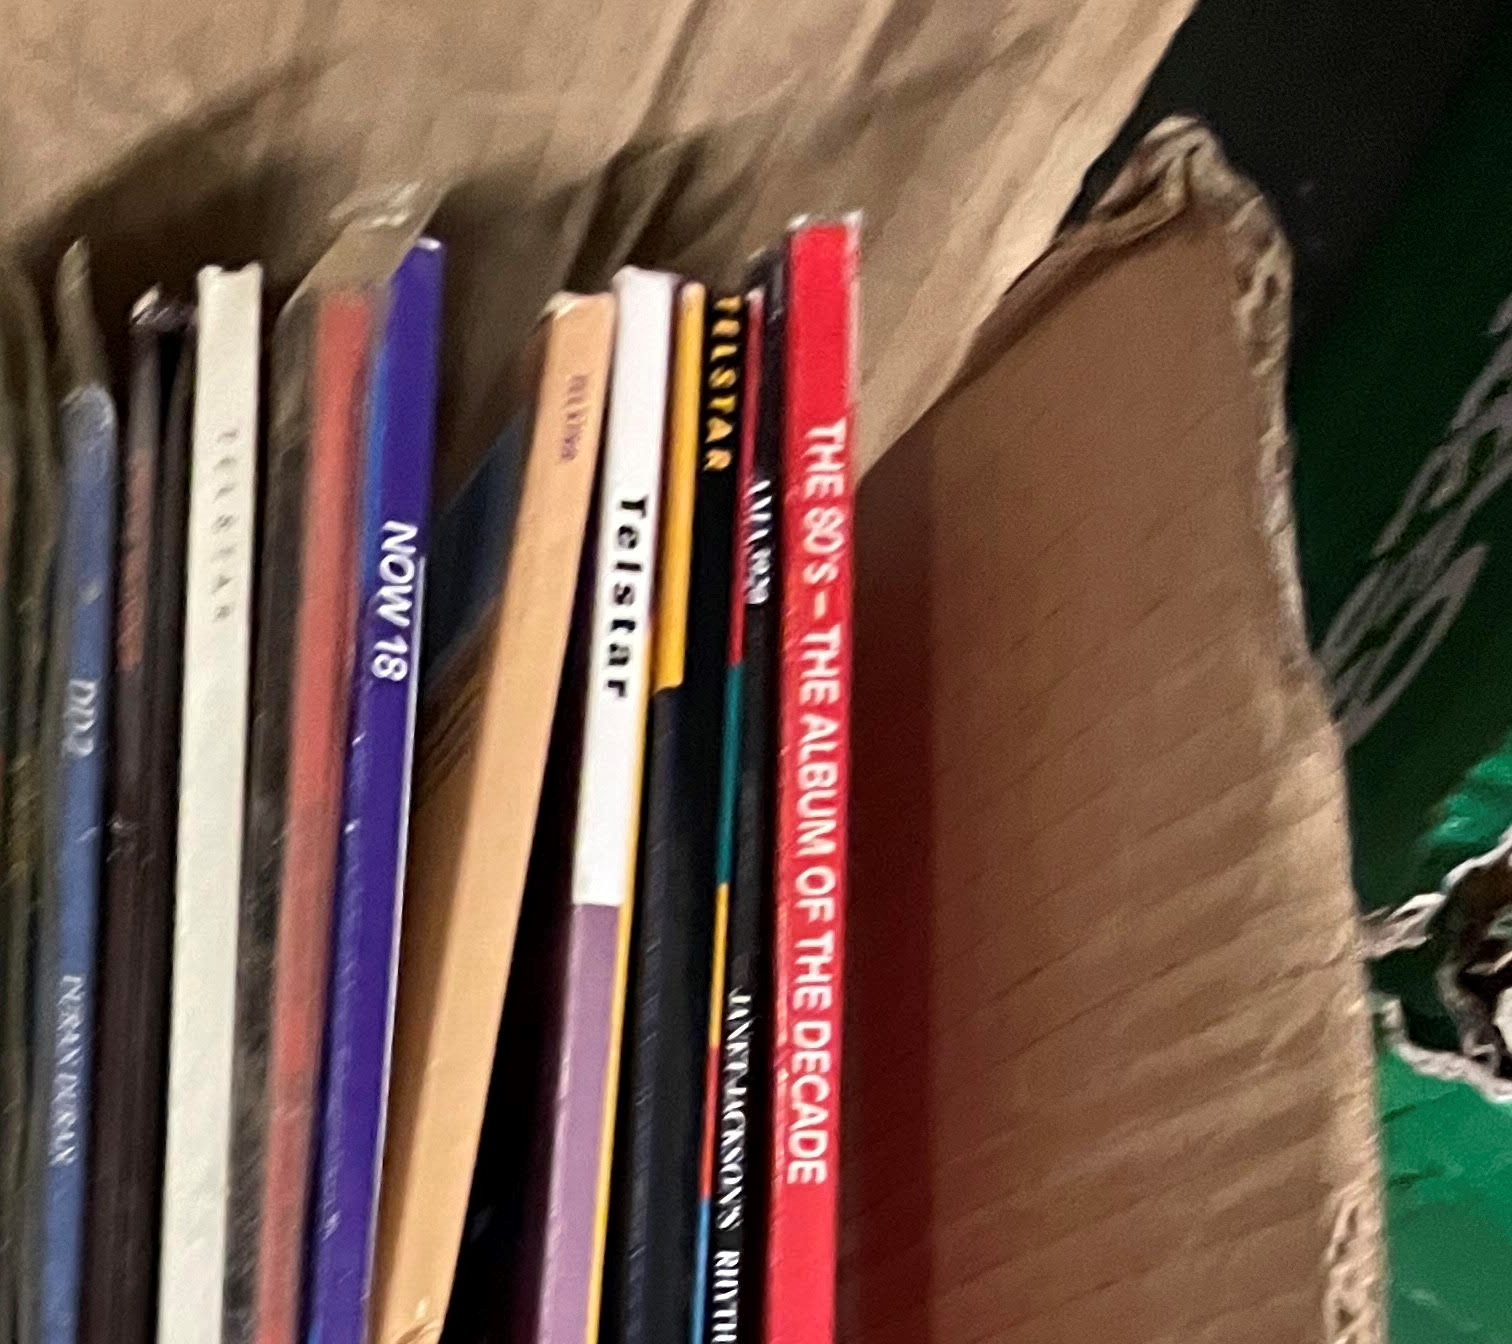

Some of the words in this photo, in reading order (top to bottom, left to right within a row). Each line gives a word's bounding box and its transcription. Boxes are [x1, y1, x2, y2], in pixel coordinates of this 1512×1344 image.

[703, 297, 741, 472] TELSTAR
[804, 421, 846, 498] THE
[212, 428, 239, 621] TELSTAR
[803, 506, 844, 583] 80's
[375, 520, 418, 627] NOW
[604, 495, 650, 699] Telstar
[372, 635, 409, 681] 18
[800, 626, 841, 701] THE
[796, 714, 839, 855] ALBUM
[798, 866, 836, 921] OF
[792, 931, 835, 1007] THE
[54, 974, 86, 1068] DURAN
[48, 1072, 82, 1167] DURAN
[787, 1020, 832, 1183] DECADE
